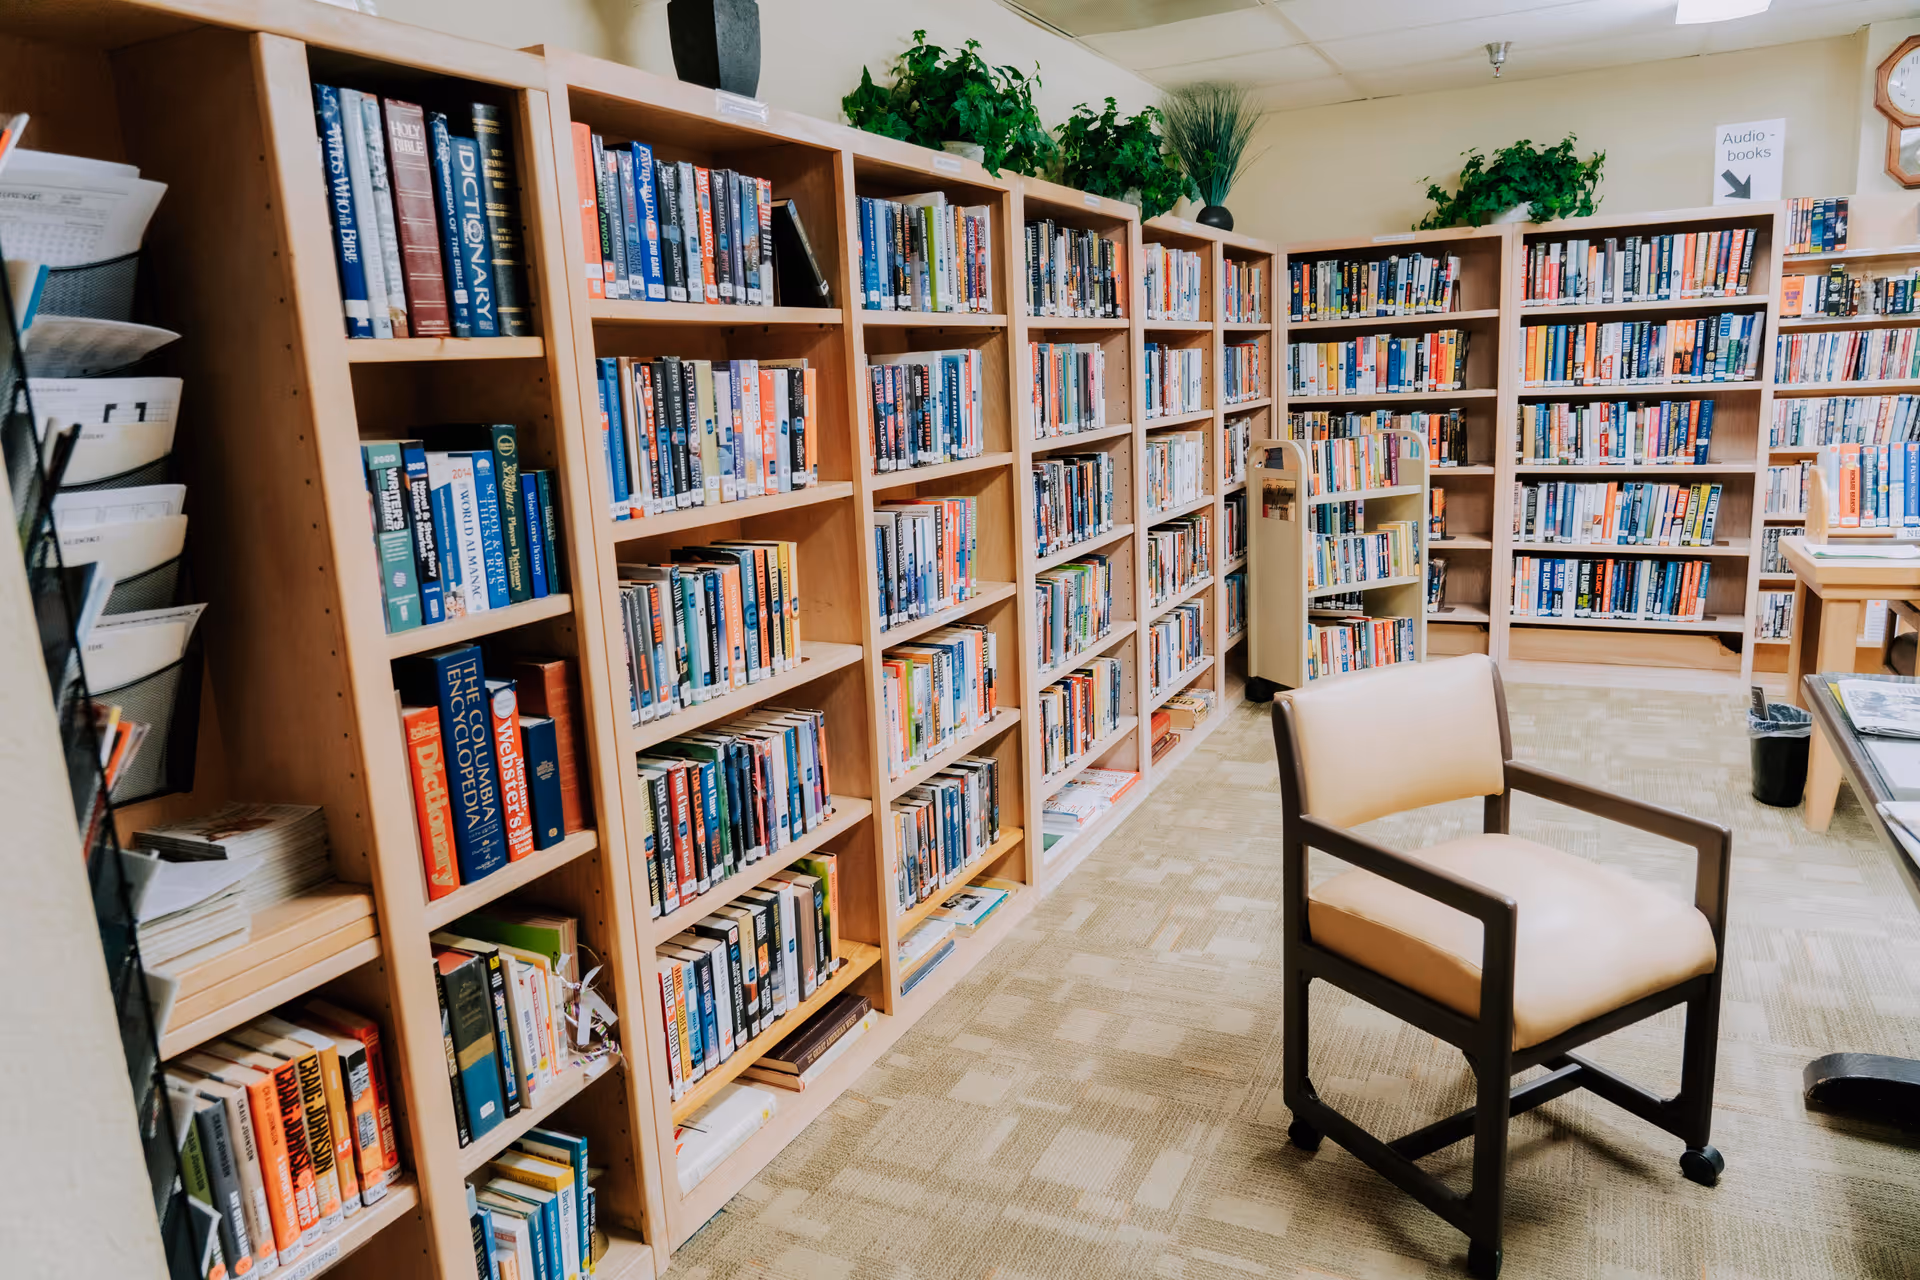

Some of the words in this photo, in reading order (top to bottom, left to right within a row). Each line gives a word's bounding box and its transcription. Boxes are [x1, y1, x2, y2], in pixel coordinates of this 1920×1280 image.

[391, 121, 421, 138] HOLY
[1722, 130, 1765, 145] Audio
[393, 138, 425, 154] BIBLE
[1727, 147, 1772, 162] books
[638, 149, 653, 184] DAVID
[334, 176, 351, 213] WHO
[747, 184, 757, 222] NEVADA
[449, 217, 457, 233] OF
[459, 150, 493, 320] DICTIONARY
[600, 212, 610, 255] ATWOOD
[613, 219, 621, 235] MAN
[452, 237, 461, 257] THE
[615, 236, 624, 261] CALLED
[649, 240, 658, 258] END
[762, 233, 772, 256] BARR
[454, 259, 464, 288] BIBLE
[651, 257, 661, 278] GAME
[1641, 323, 1650, 346] NEVADA
[1632, 343, 1640, 360] HARD
[1640, 346, 1648, 362] BARR
[656, 372, 665, 397] STEVE
[671, 362, 681, 392] STEVE
[686, 365, 697, 400] STEVE
[658, 400, 668, 429] BERRY
[674, 395, 684, 429] BERRY
[385, 468, 405, 530] WRITER'S
[411, 481, 423, 521] Writer's
[418, 480, 429, 510] Novel
[381, 490, 395, 531] MARKET
[422, 511, 430, 520] &
[460, 489, 475, 536] WORLD
[485, 483, 499, 537] SCHOOL
[423, 522, 435, 550] Short
[479, 497, 497, 586] THESAURUS
[492, 539, 501, 549] &
[507, 516, 518, 547] Players
[526, 491, 538, 520] Webster's
[532, 544, 542, 576] Dictionary
[897, 516, 905, 544] Nelson
[1906, 529, 1920, 538] NE
[427, 551, 438, 577] Story
[465, 539, 482, 600] ALMANAC
[494, 551, 507, 596] OFFICE
[511, 547, 522, 592] Dictionary
[897, 545, 906, 576] DeMille
[1543, 561, 1551, 574] TOM
[1582, 562, 1591, 576] TOM
[1596, 563, 1604, 575] TOM
[747, 586, 755, 603] WAY
[759, 582, 767, 607] CHILD
[1542, 574, 1551, 591] CLANCY
[1580, 576, 1590, 594] CLANCY
[1594, 575, 1603, 595] CLANCY
[650, 587, 660, 617] SANDRA
[730, 584, 738, 618] ROBYN
[654, 617, 663, 643] BROWN
[732, 618, 740, 646] CARR
[749, 629, 757, 645] LEE
[711, 627, 719, 666] TEMPERATURES
[750, 645, 760, 669] CHILD
[464, 663, 481, 705] THE
[447, 668, 481, 830] ENCYCLOPEDIA
[469, 708, 496, 822] COLUMBIA
[496, 719, 522, 829] Webster's
[706, 766, 718, 789] Tom
[514, 757, 528, 816] Merriam-
[656, 777, 668, 806] TOM
[692, 767, 700, 793] TOM
[640, 782, 649, 810] LINCOLN
[416, 743, 454, 887] Dictionary
[674, 768, 687, 794] Tom
[682, 850, 691, 878] Rabbit
[659, 807, 672, 852] CLANCY
[649, 863, 658, 881] DEEP
[651, 882, 660, 905] STORM
[760, 913, 768, 937] MICHAEL
[701, 965, 711, 992] HARLAN
[704, 993, 712, 1016] COBEN
[764, 986, 773, 1011] CONCRETE
[677, 1004, 688, 1035] COBEN
[691, 1012, 699, 1031] HOLD
[668, 1021, 680, 1059] COBEN
[443, 1035, 458, 1078] ATLAS
[274, 1064, 299, 1117] CRAIG
[299, 1054, 323, 1106] CRAIG
[237, 1099, 248, 1124] CRAIG
[263, 1085, 273, 1112] CRAIG
[212, 1113, 225, 1140] CRAIG
[266, 1112, 280, 1147] JOHNSON
[305, 1104, 334, 1175] JOHNSON
[241, 1125, 255, 1162] JOHNSON
[191, 1153, 206, 1193] JOHNSON
[216, 1140, 231, 1179] JOHNSON
[297, 1186, 312, 1227] WOLVES
[561, 1189, 571, 1217] Birds
